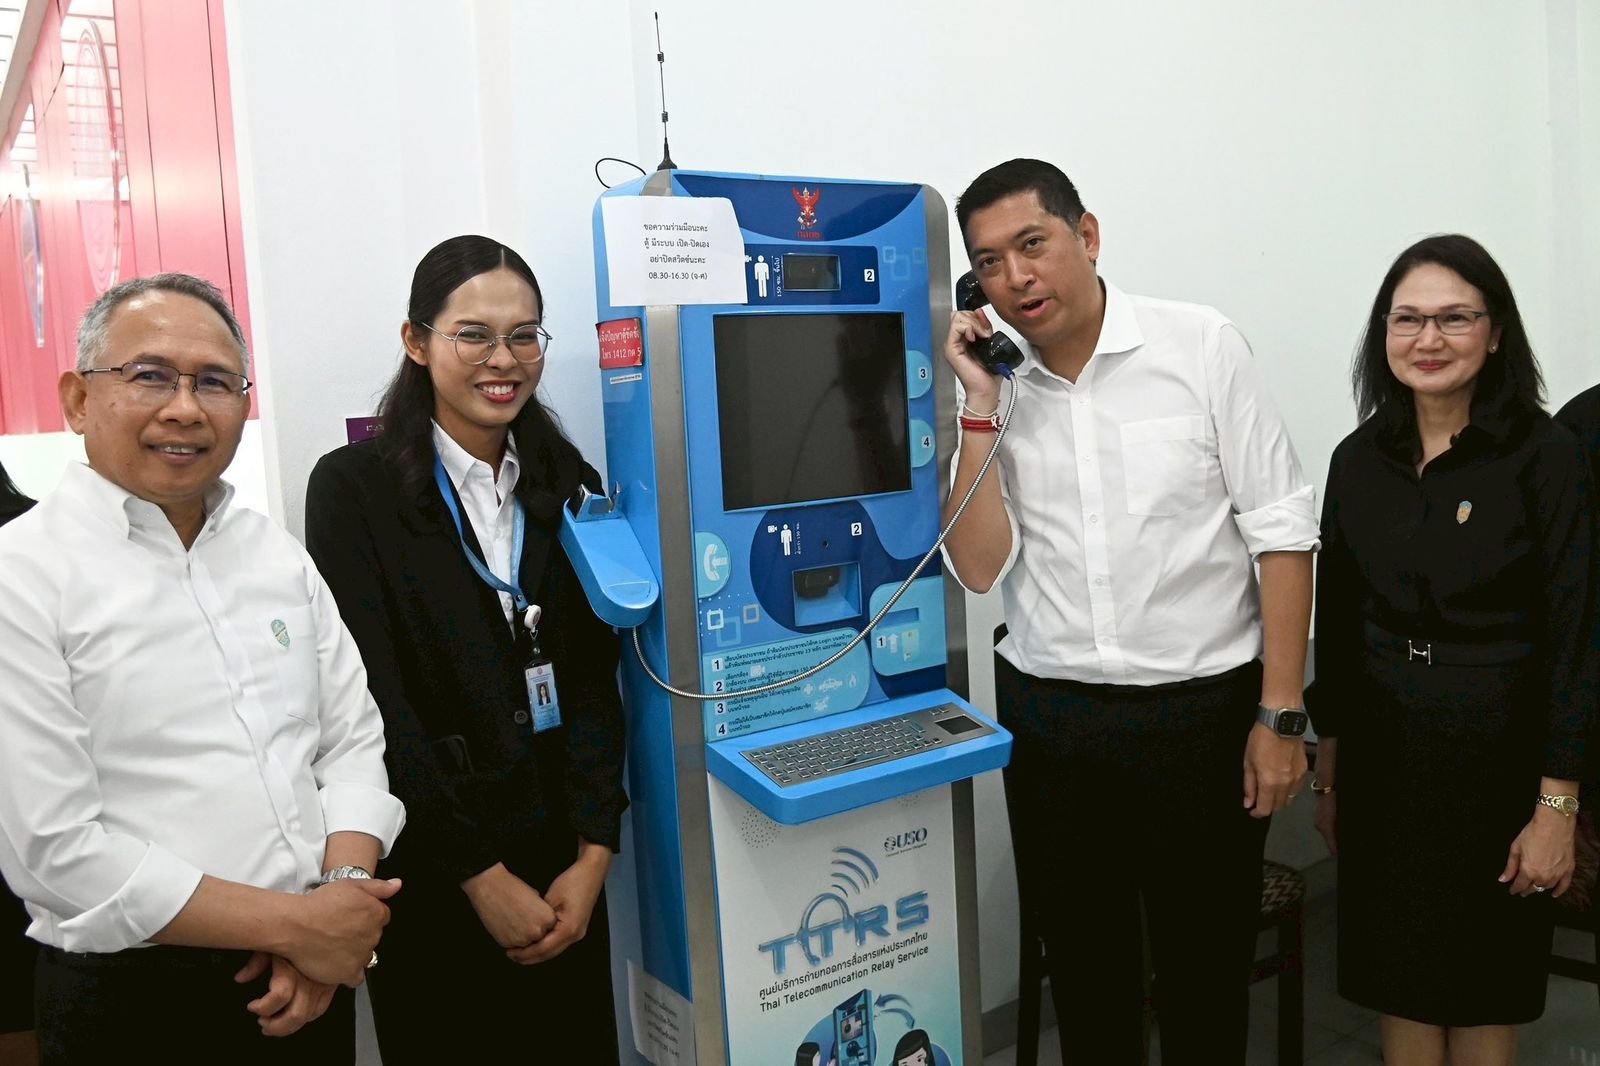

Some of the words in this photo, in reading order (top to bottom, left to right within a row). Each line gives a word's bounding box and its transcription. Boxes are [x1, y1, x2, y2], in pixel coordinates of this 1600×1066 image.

[643, 222, 708, 232] ขอความร่วมมือนะคะ
[651, 237, 675, 247] มีระบบ
[676, 238, 710, 248] เปิด-ปิดเอง
[648, 271, 690, 280] 08.30-16.30
[866, 270, 873, 281] 2
[612, 348, 627, 359] 1412
[920, 368, 927, 379] 3
[923, 436, 930, 447] 4
[853, 524, 860, 535] 2
[714, 659, 721, 670] 1
[715, 681, 723, 692] 2
[717, 702, 724, 714] 3
[718, 723, 726, 735] 4
[896, 827, 928, 848] USO
[759, 931, 928, 1001] ศูนย์บริการถ่ายทอดการสื่อสารแห่งประเทศไทย
[759, 997, 781, 1013] Thai
[783, 968, 869, 1004] Telecommunication
[871, 957, 895, 974] Relay
[897, 945, 929, 964] Service
